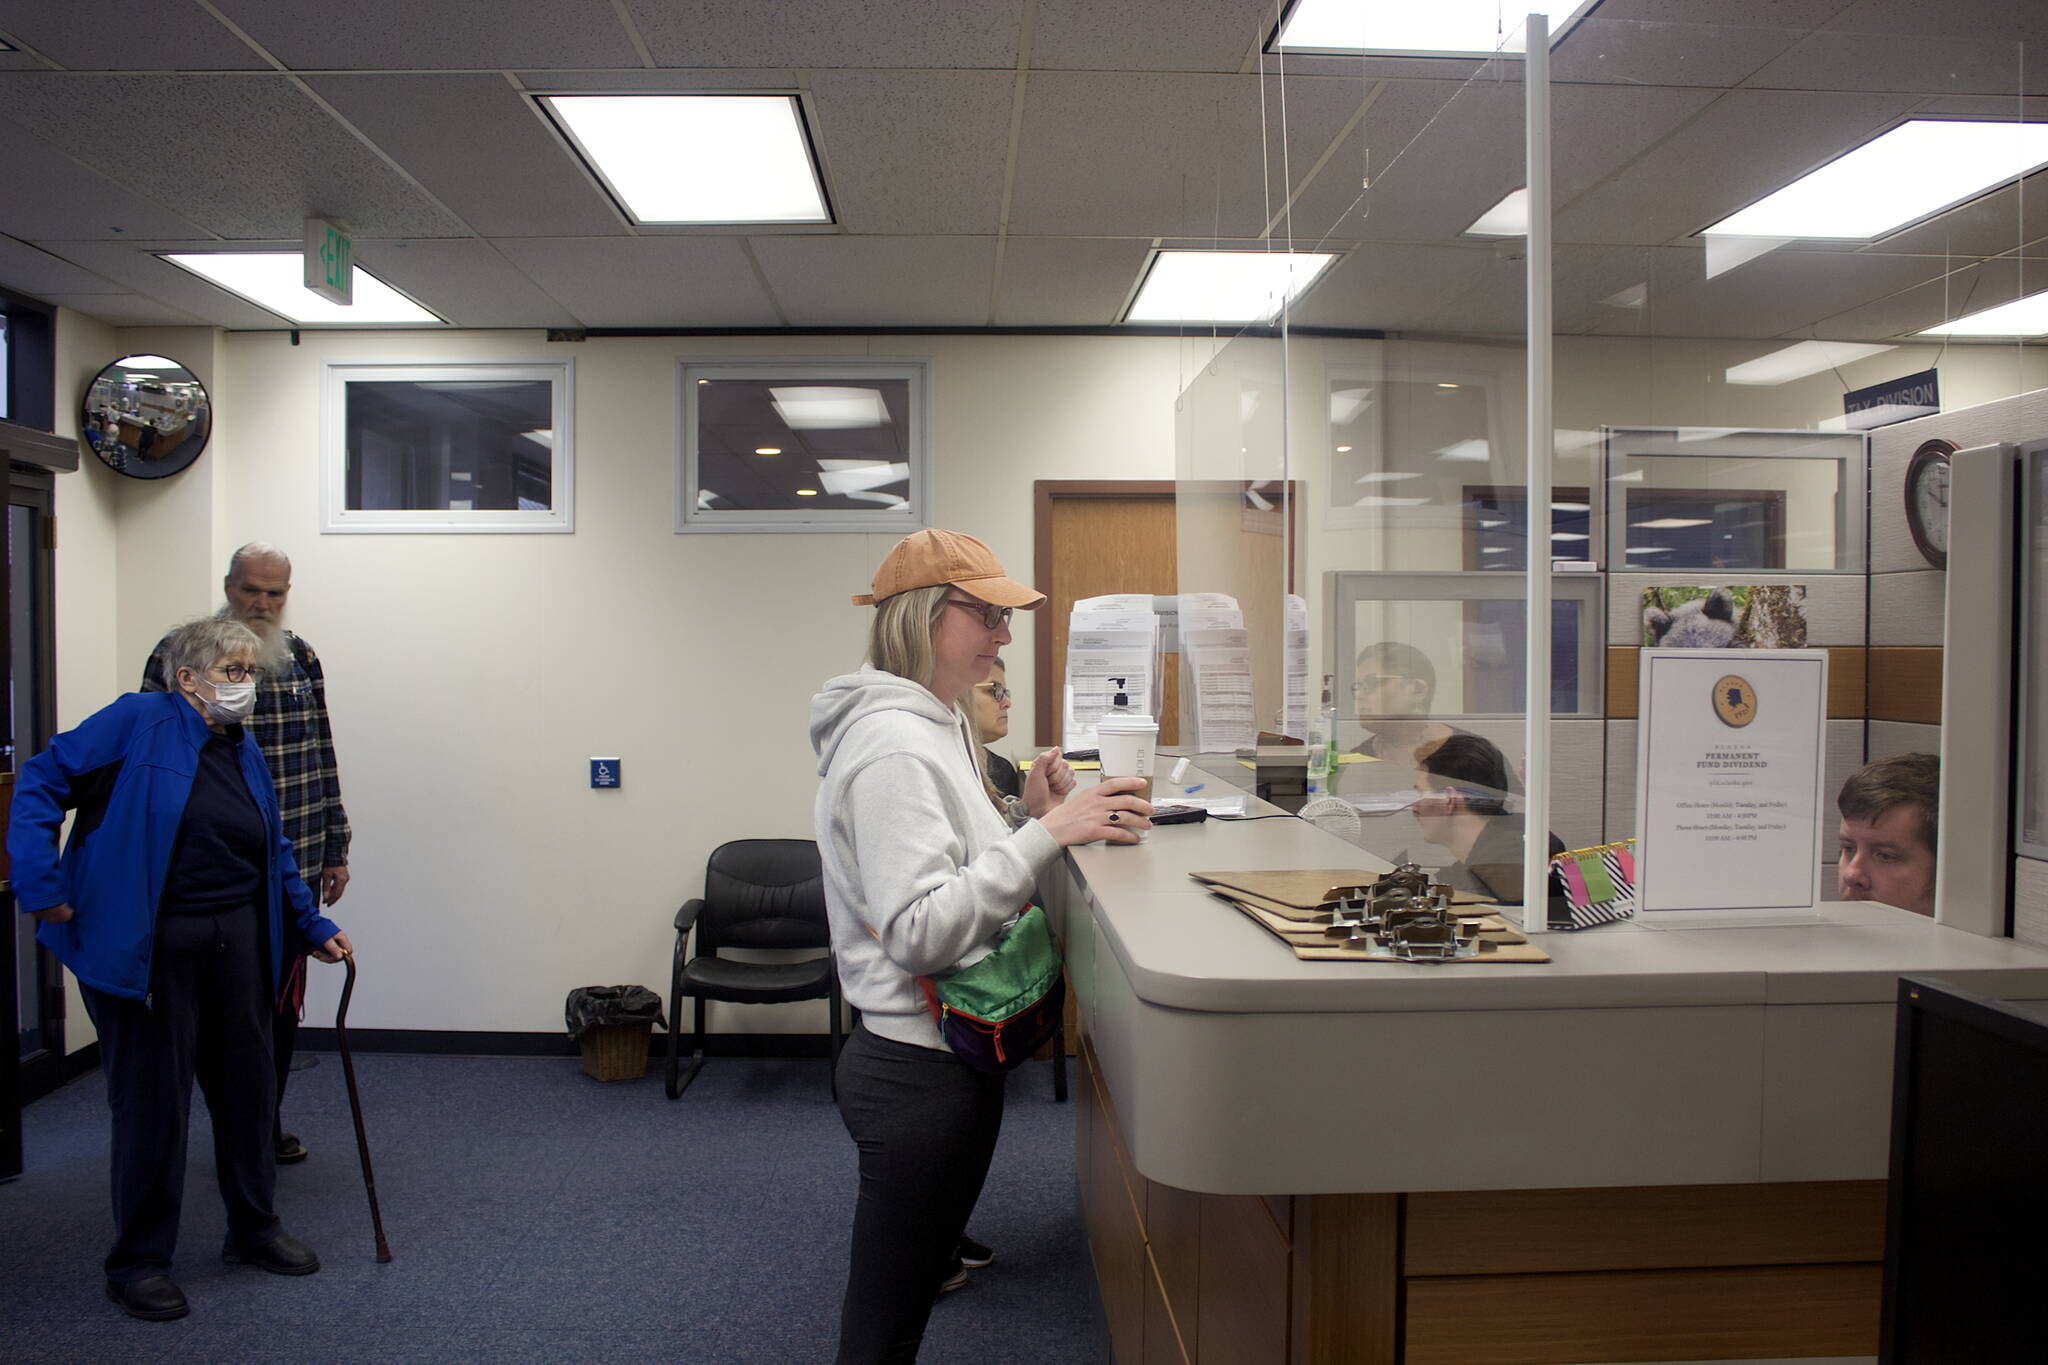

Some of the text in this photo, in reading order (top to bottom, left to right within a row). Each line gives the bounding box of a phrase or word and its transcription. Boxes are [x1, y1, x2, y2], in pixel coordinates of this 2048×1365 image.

[326, 227, 351, 295] EXIT
[1876, 383, 1934, 410] DIVISION
[1705, 752, 1760, 760] PERMANENT
[1722, 761, 1768, 769] DIVIDEND
